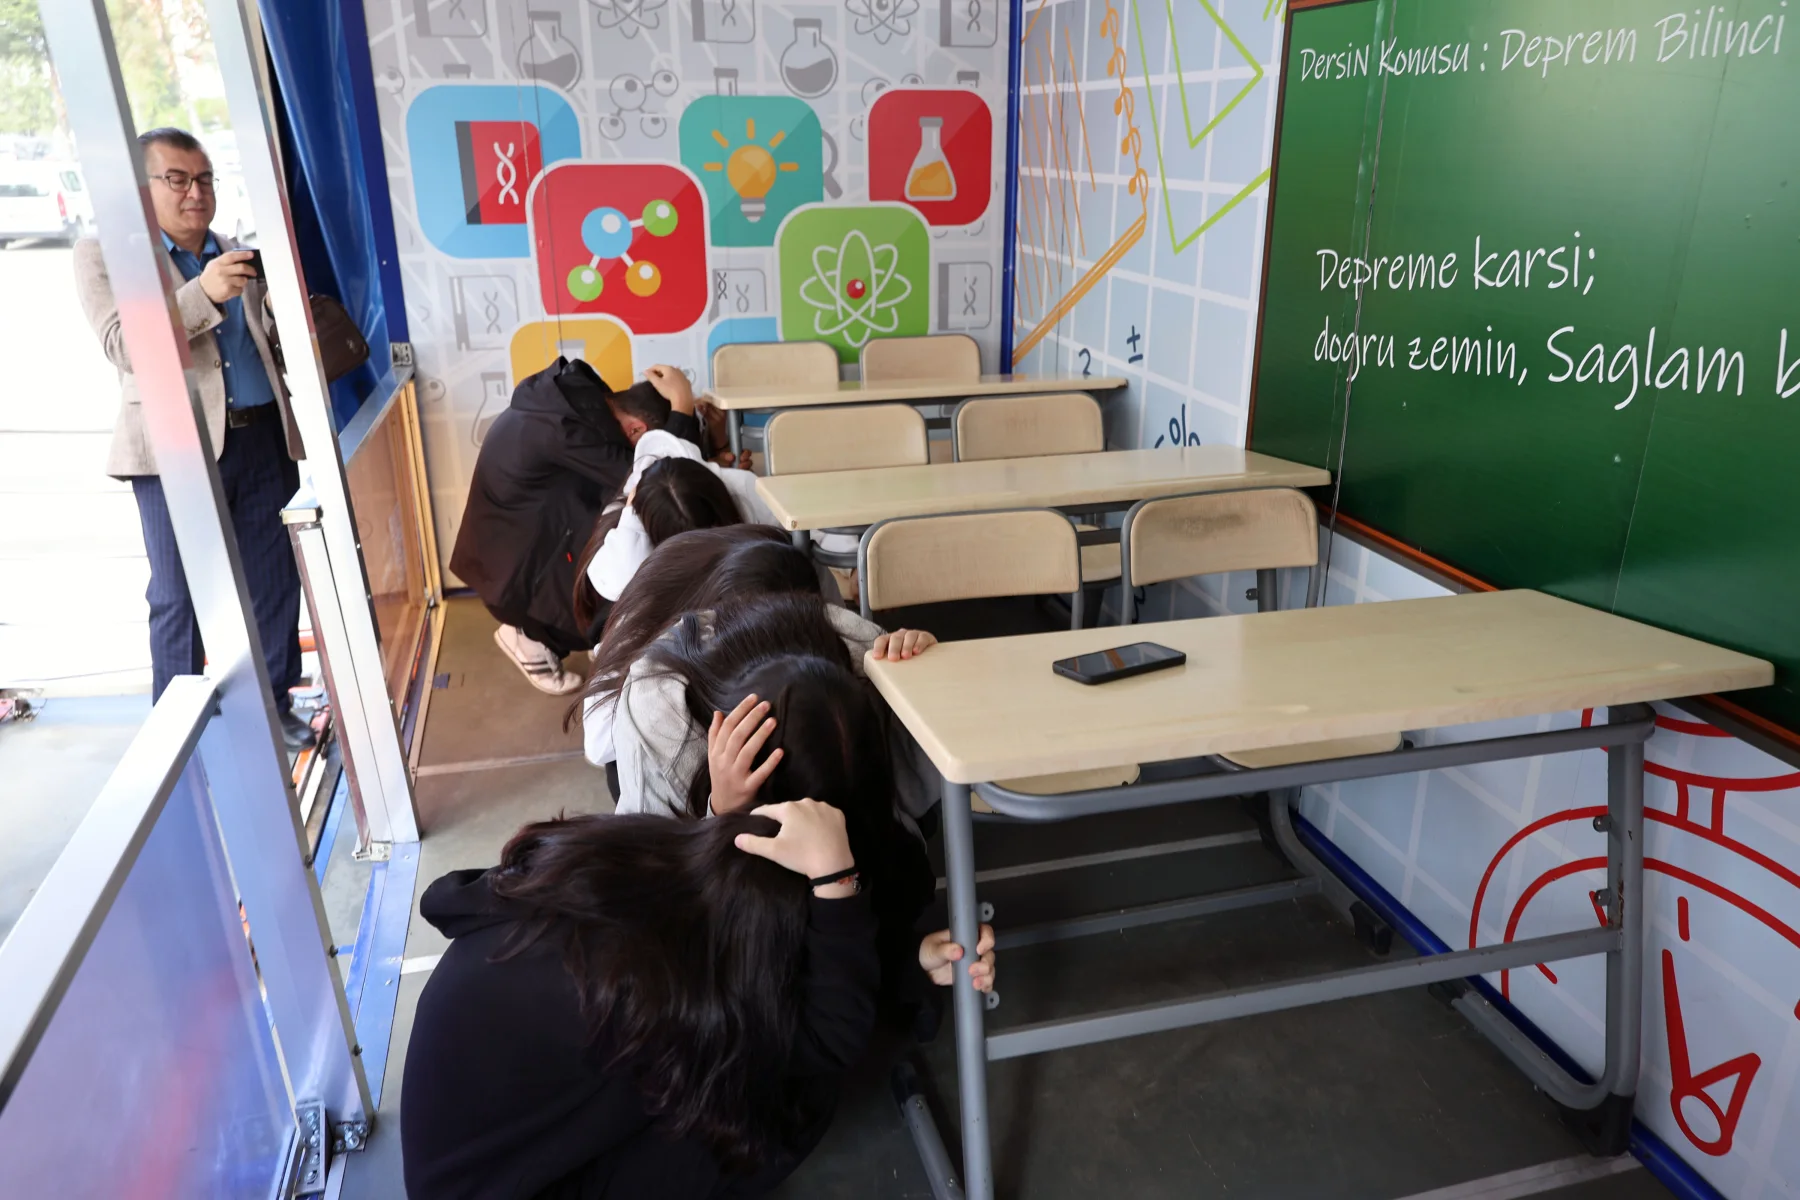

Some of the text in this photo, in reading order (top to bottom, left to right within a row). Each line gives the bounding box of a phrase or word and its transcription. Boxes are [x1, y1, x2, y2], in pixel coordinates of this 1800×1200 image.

[1378, 35, 1470, 77] Konusu
[1499, 28, 1637, 79] Deprem
[1653, 0, 1788, 63] Bilinci
[1316, 230, 1596, 300] Depreme karsi;
[1314, 315, 1395, 383] dogru
[1407, 324, 1528, 386] zemin,
[1546, 325, 1745, 411] Saglam
